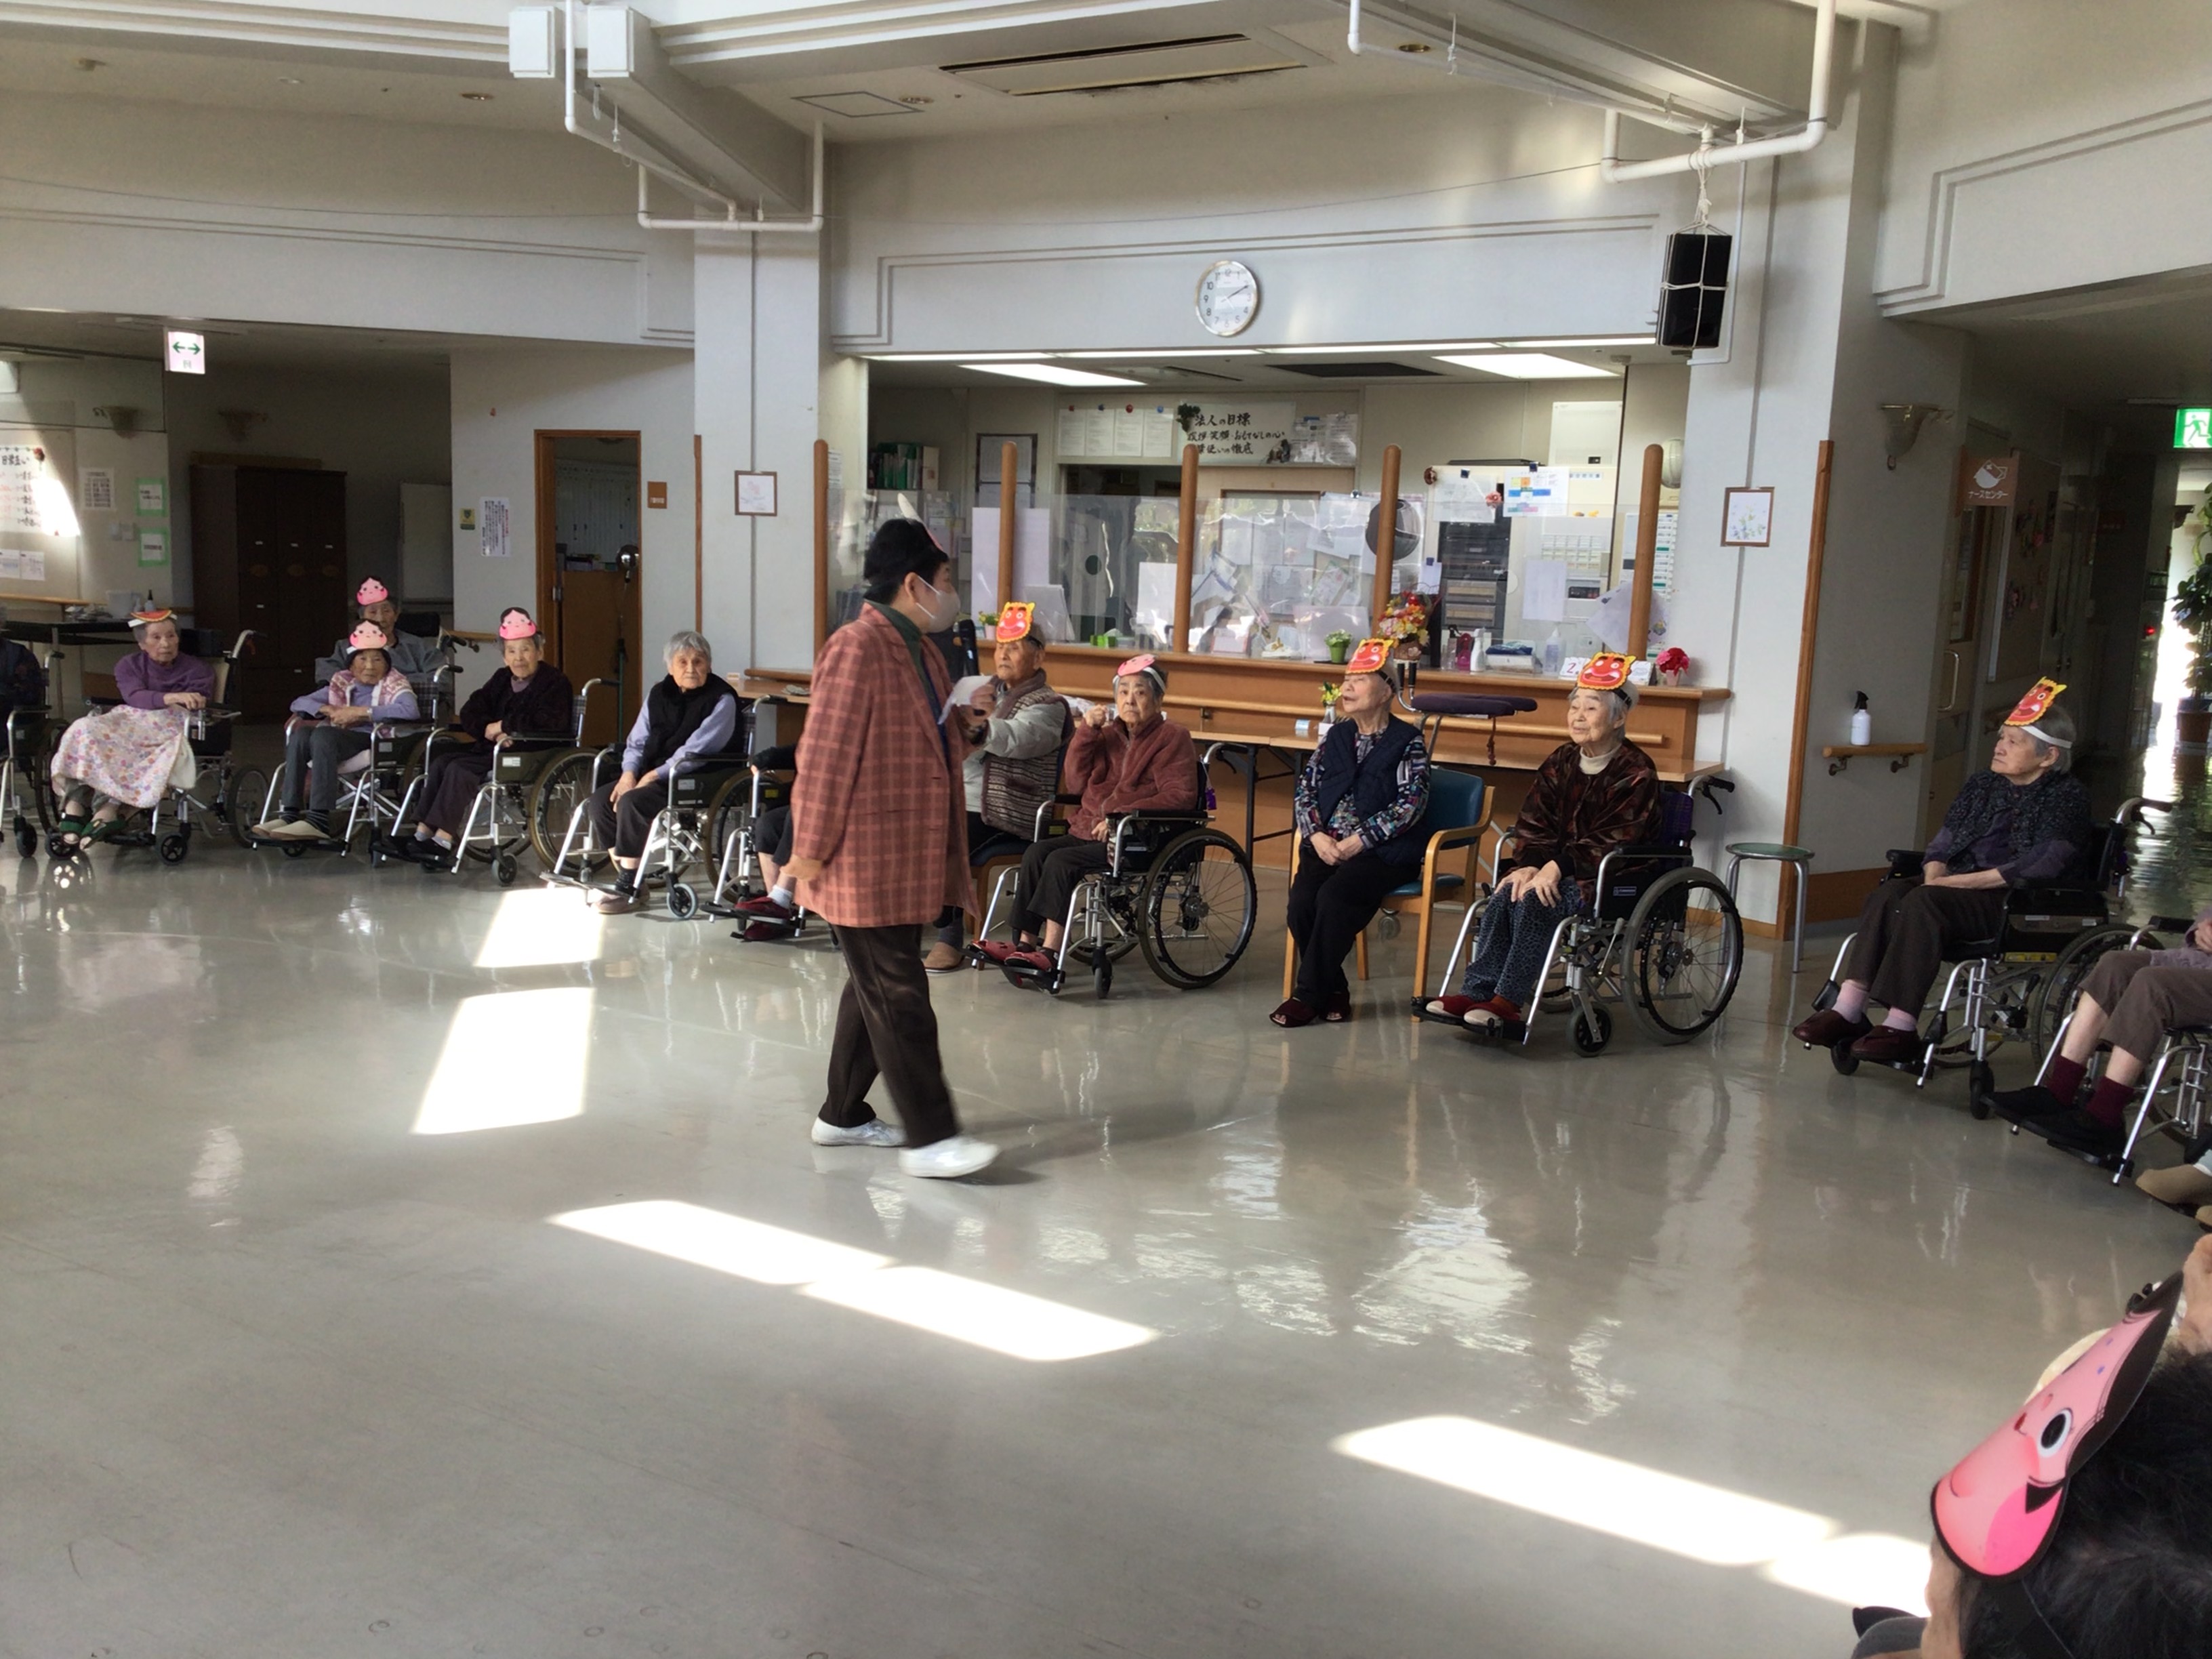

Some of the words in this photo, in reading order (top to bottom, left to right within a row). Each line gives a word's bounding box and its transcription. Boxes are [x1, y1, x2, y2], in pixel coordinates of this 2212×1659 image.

[1206, 281, 1214, 290] 10
[1204, 294, 1209, 302] 9
[1206, 308, 1212, 316] 8
[1214, 316, 1219, 325] 7
[1235, 315, 1240, 323] 5
[1968, 489, 2009, 499] ナースセンター
